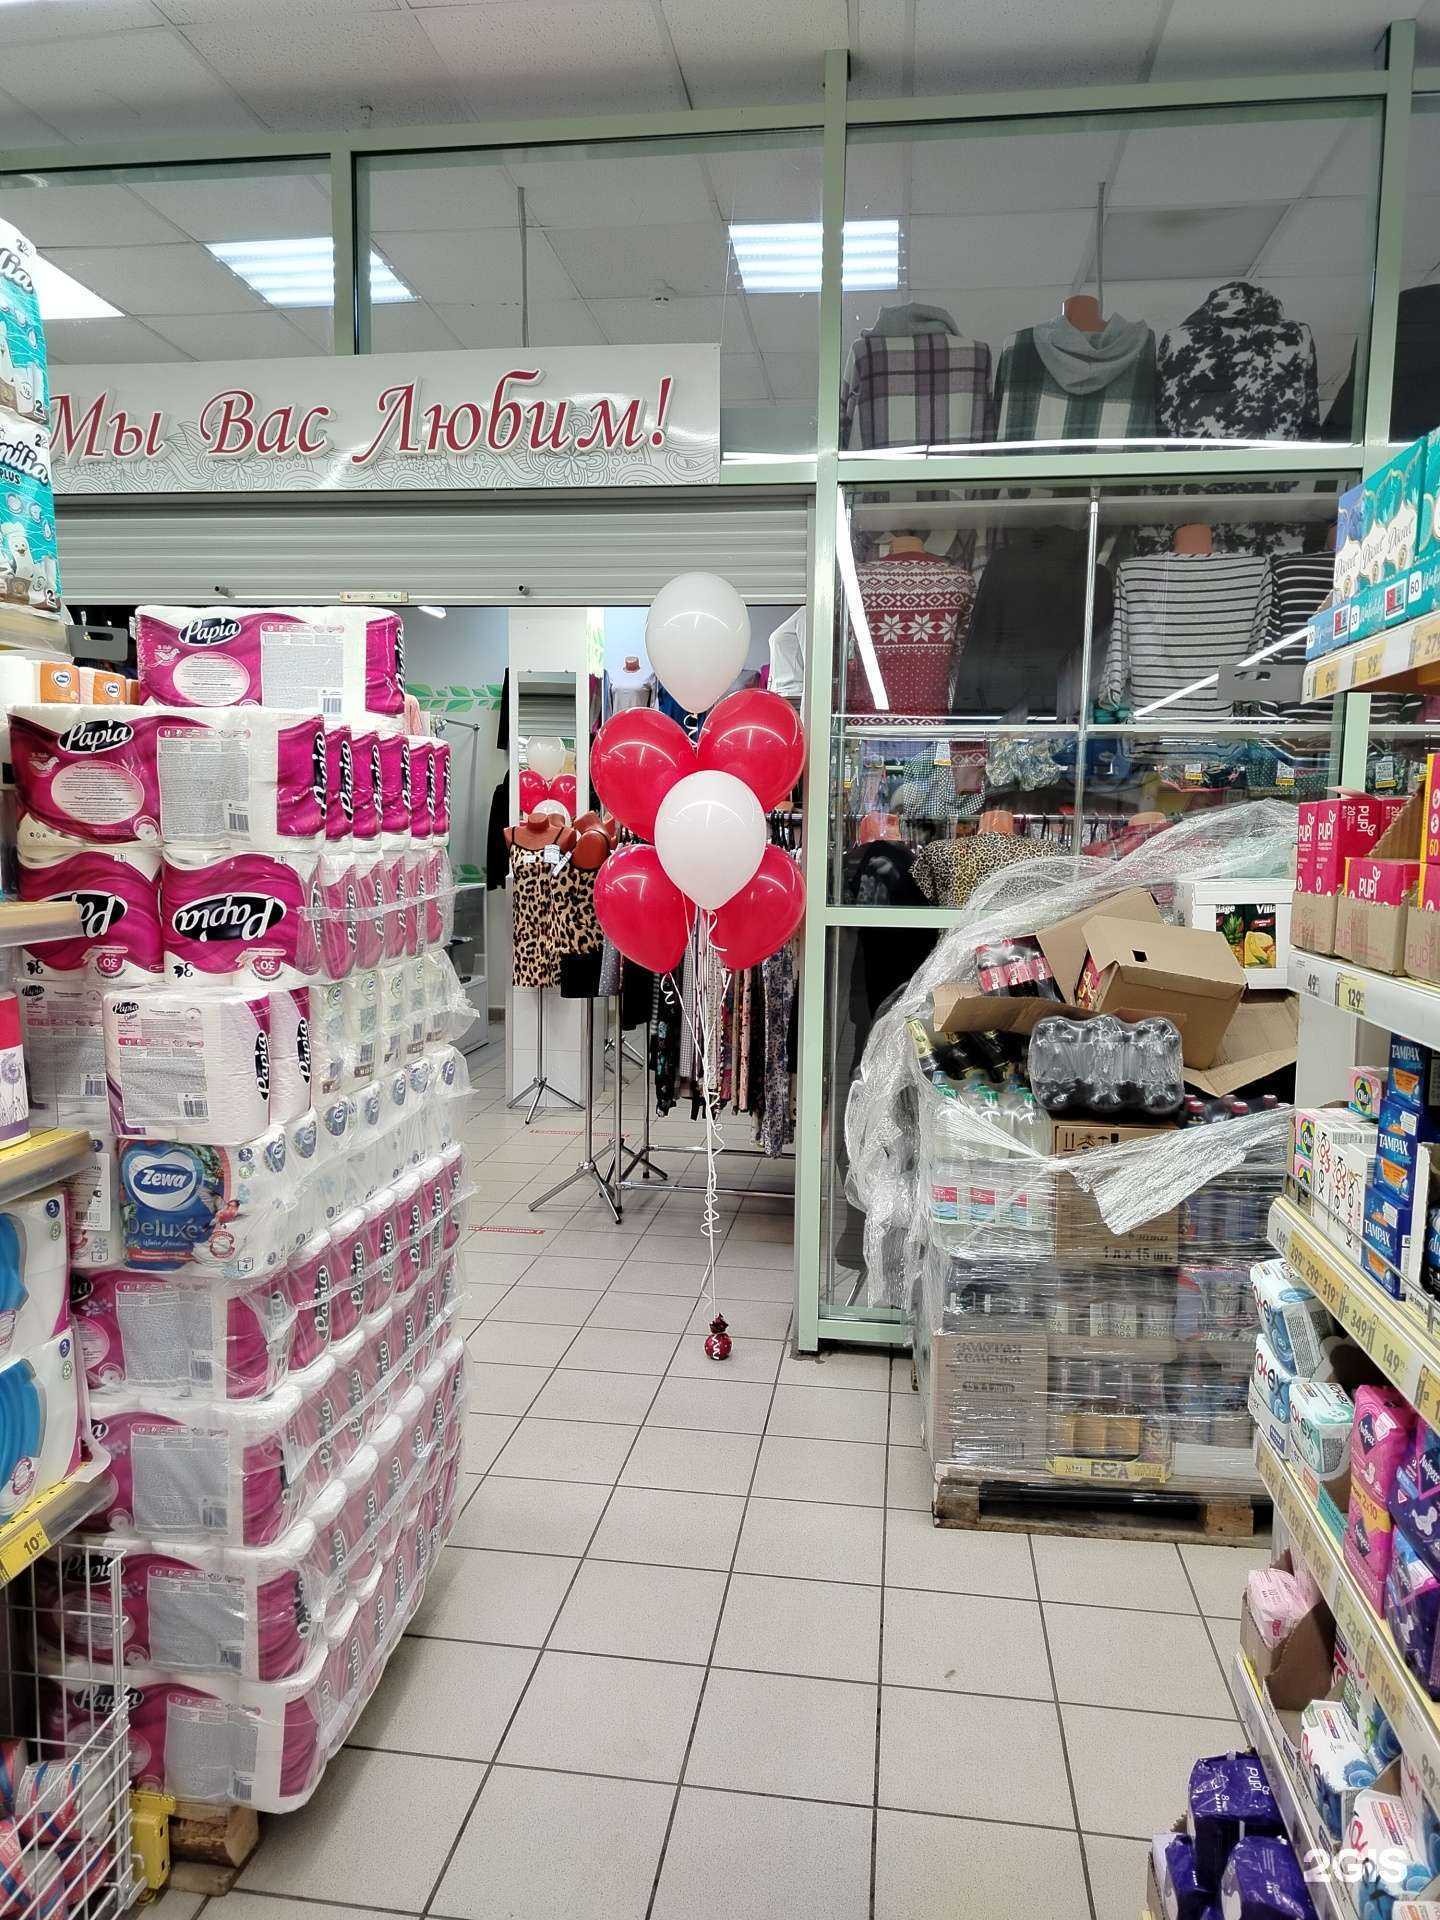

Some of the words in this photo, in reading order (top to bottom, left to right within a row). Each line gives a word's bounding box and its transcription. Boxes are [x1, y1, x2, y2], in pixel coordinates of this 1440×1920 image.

[49, 393, 165, 458] Мы
[199, 390, 331, 455] Вас
[352, 368, 673, 465] Любим!
[1410, 580, 1420, 593] 60
[184, 618, 239, 645] Papia
[65, 719, 129, 752] Papia
[178, 896, 275, 942] Papia
[1348, 988, 1361, 1008] 129
[297, 1020, 311, 1078] Papia
[1391, 1044, 1420, 1061] TAMPAX
[255, 1033, 271, 1095] Papia
[1379, 1133, 1409, 1156] TAMPAX
[141, 1169, 189, 1188] Zewa
[127, 1217, 199, 1240] Deluxe
[1364, 1219, 1391, 1247] TAMPAX
[1322, 1278, 1336, 1303] 319
[1350, 1310, 1367, 1337] 349
[1383, 1344, 1400, 1373] 149
[24, 1537, 39, 1555] 10
[1421, 1754, 1436, 1788] 99
